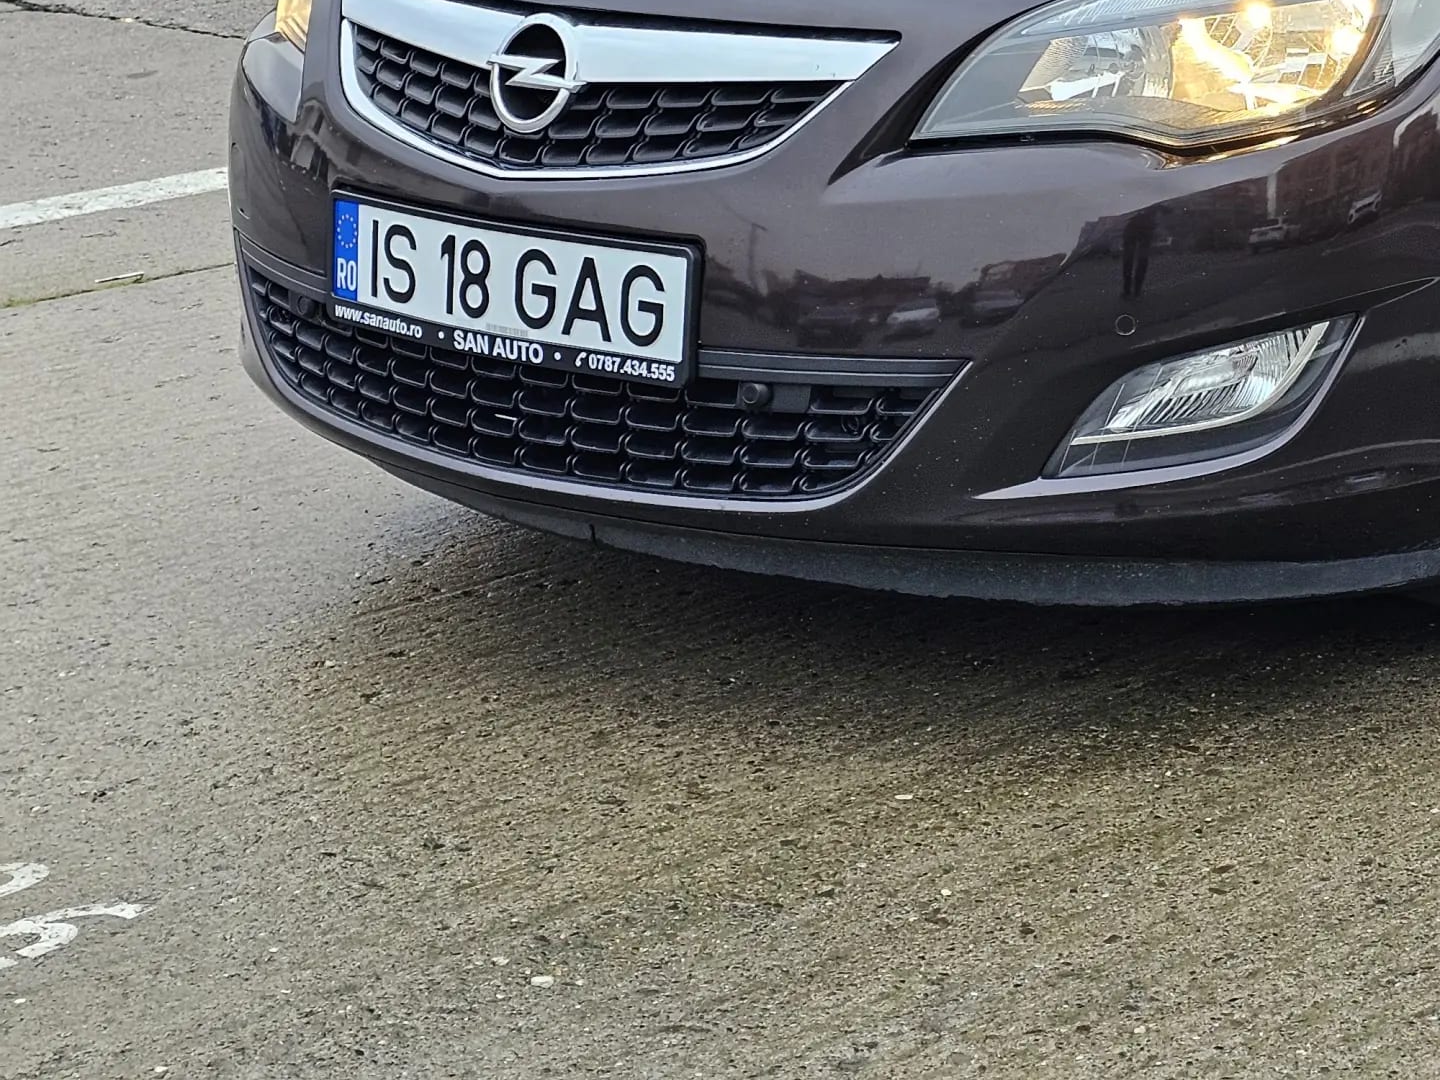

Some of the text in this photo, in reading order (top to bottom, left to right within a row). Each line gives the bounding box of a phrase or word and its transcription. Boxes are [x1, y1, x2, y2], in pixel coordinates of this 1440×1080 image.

[336, 257, 358, 292] RO
[371, 219, 666, 347] IS 18 GAG
[335, 304, 675, 382] www.sanauto.ro SAN AUTO 0787.434.555
